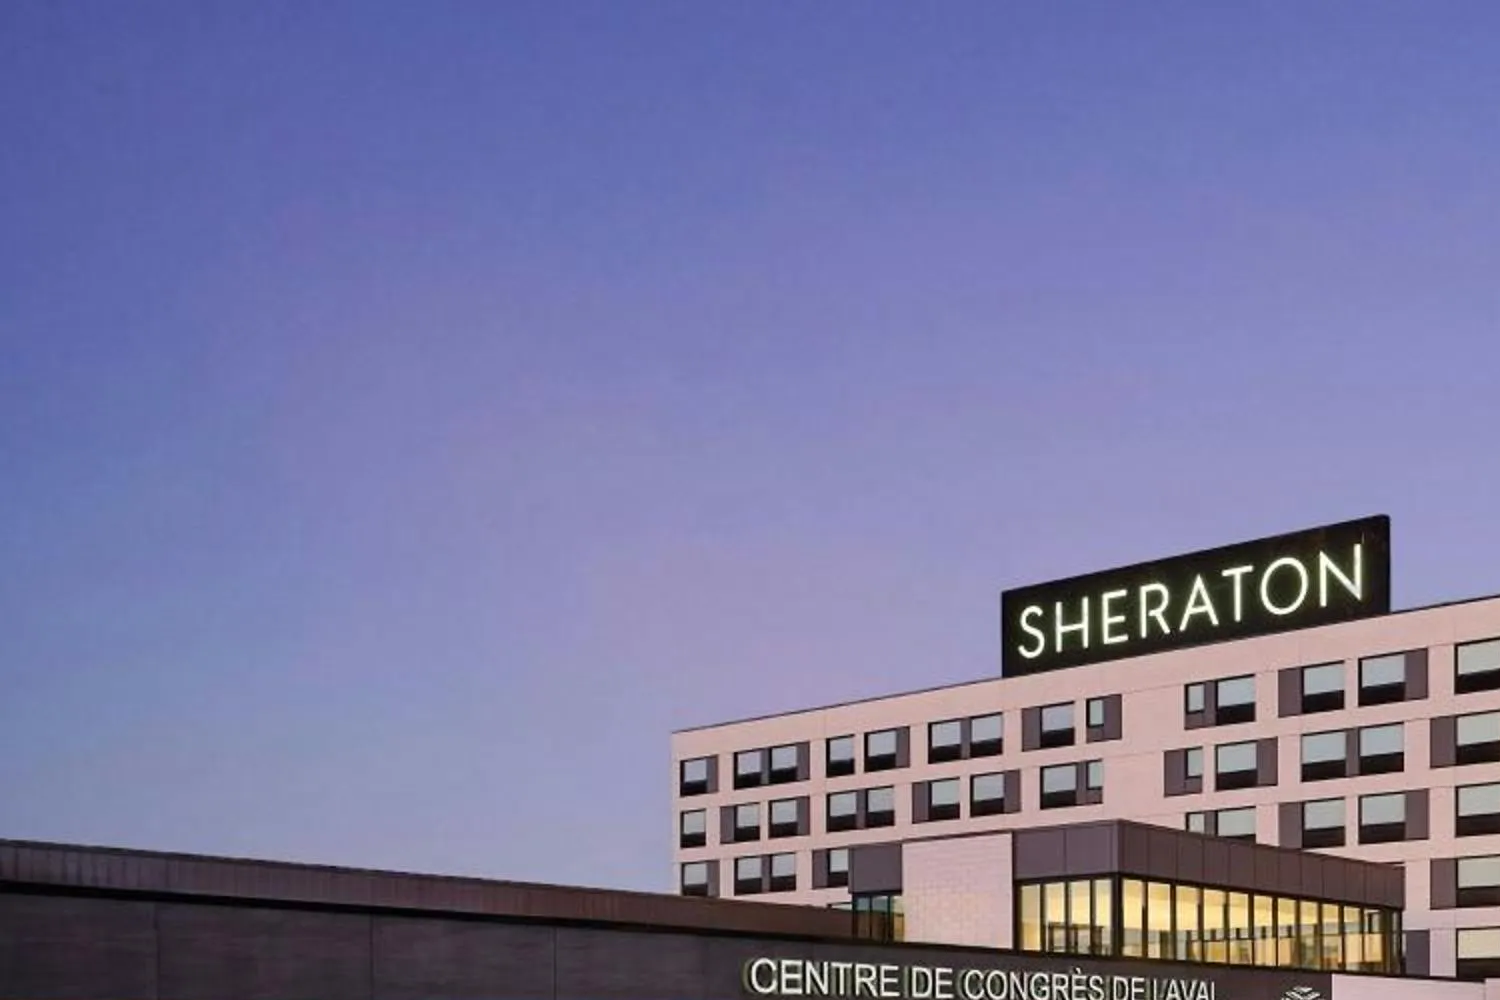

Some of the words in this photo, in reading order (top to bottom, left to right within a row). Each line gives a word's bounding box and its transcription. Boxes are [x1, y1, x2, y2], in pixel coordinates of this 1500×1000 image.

[1018, 543, 1363, 659] SHERATON
[750, 957, 900, 997] CENTRE
[912, 966, 954, 999] DE
